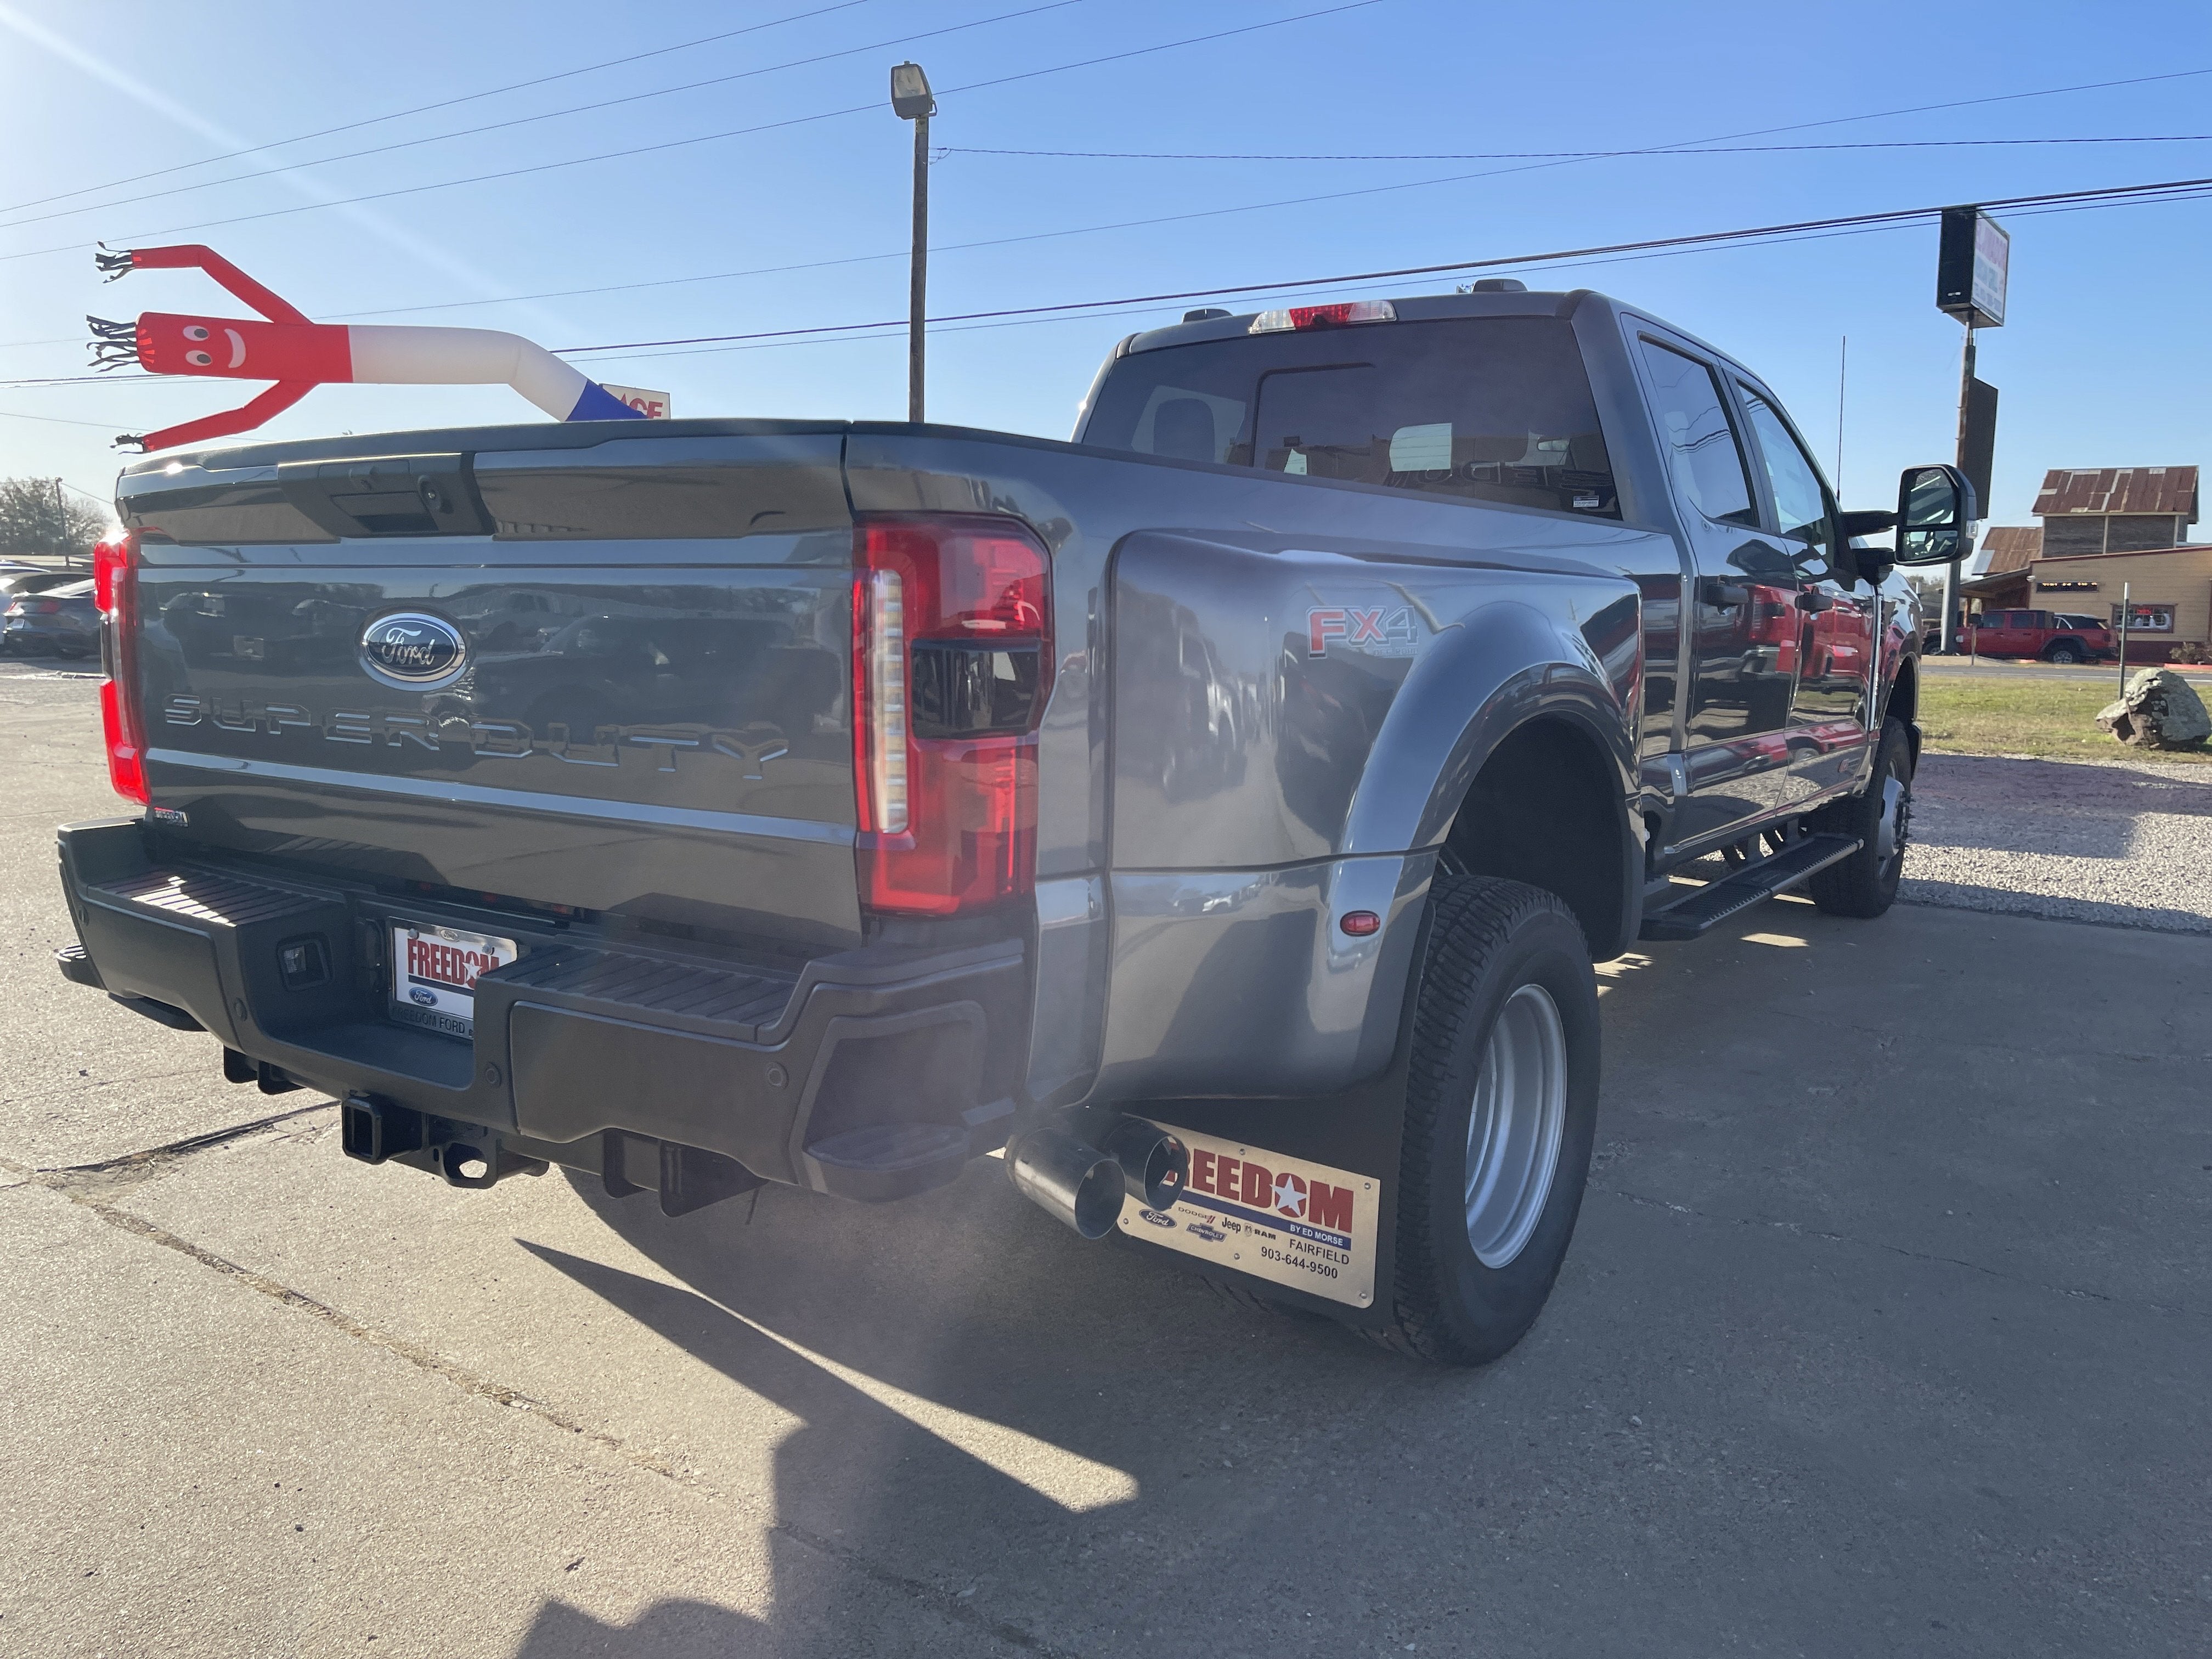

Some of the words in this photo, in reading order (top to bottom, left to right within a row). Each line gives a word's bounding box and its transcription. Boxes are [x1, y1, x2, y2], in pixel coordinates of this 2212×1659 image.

[1307, 606, 1418, 658] FX4
[381, 627, 436, 665] Ford
[165, 693, 440, 751] SUPER
[470, 717, 790, 780] DUTY
[414, 990, 432, 1004] Ford
[439, 1017, 465, 1034] FORD
[1146, 1211, 1170, 1226] Ford
[1222, 1217, 1241, 1234] Jeep
[1190, 1226, 1223, 1239] CHEVROLET
[1254, 1228, 1277, 1240] RAM
[1290, 1224, 1301, 1233] BY
[1302, 1228, 1313, 1237] ED
[1314, 1231, 1344, 1246] MORSE
[1290, 1238, 1350, 1265] FAIRFIELD
[1261, 1246, 1338, 1279] 903-644-9500
